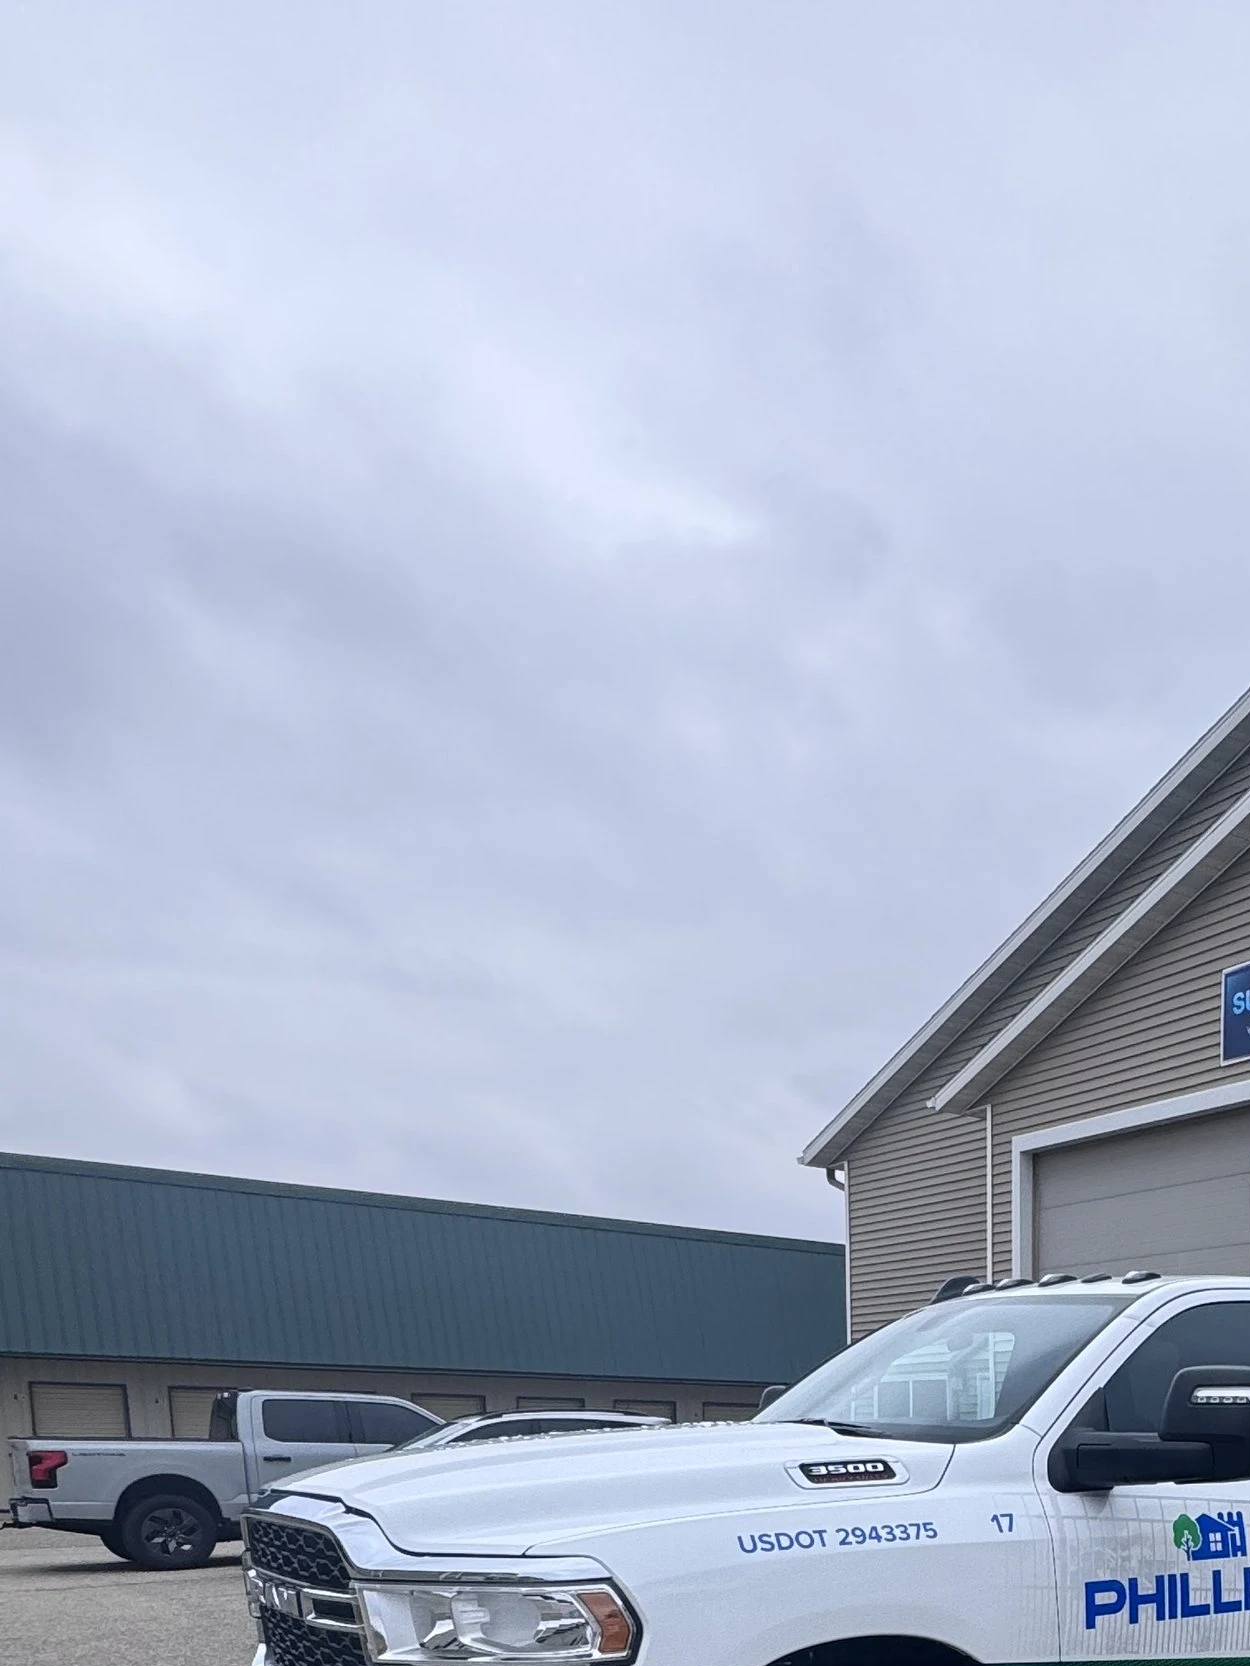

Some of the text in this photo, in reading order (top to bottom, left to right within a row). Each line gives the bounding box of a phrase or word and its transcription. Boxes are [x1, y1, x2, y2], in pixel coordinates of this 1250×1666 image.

[808, 1462, 884, 1475] 3500
[990, 1513, 1014, 1533] 17
[737, 1522, 938, 1554] USDOT 2943375
